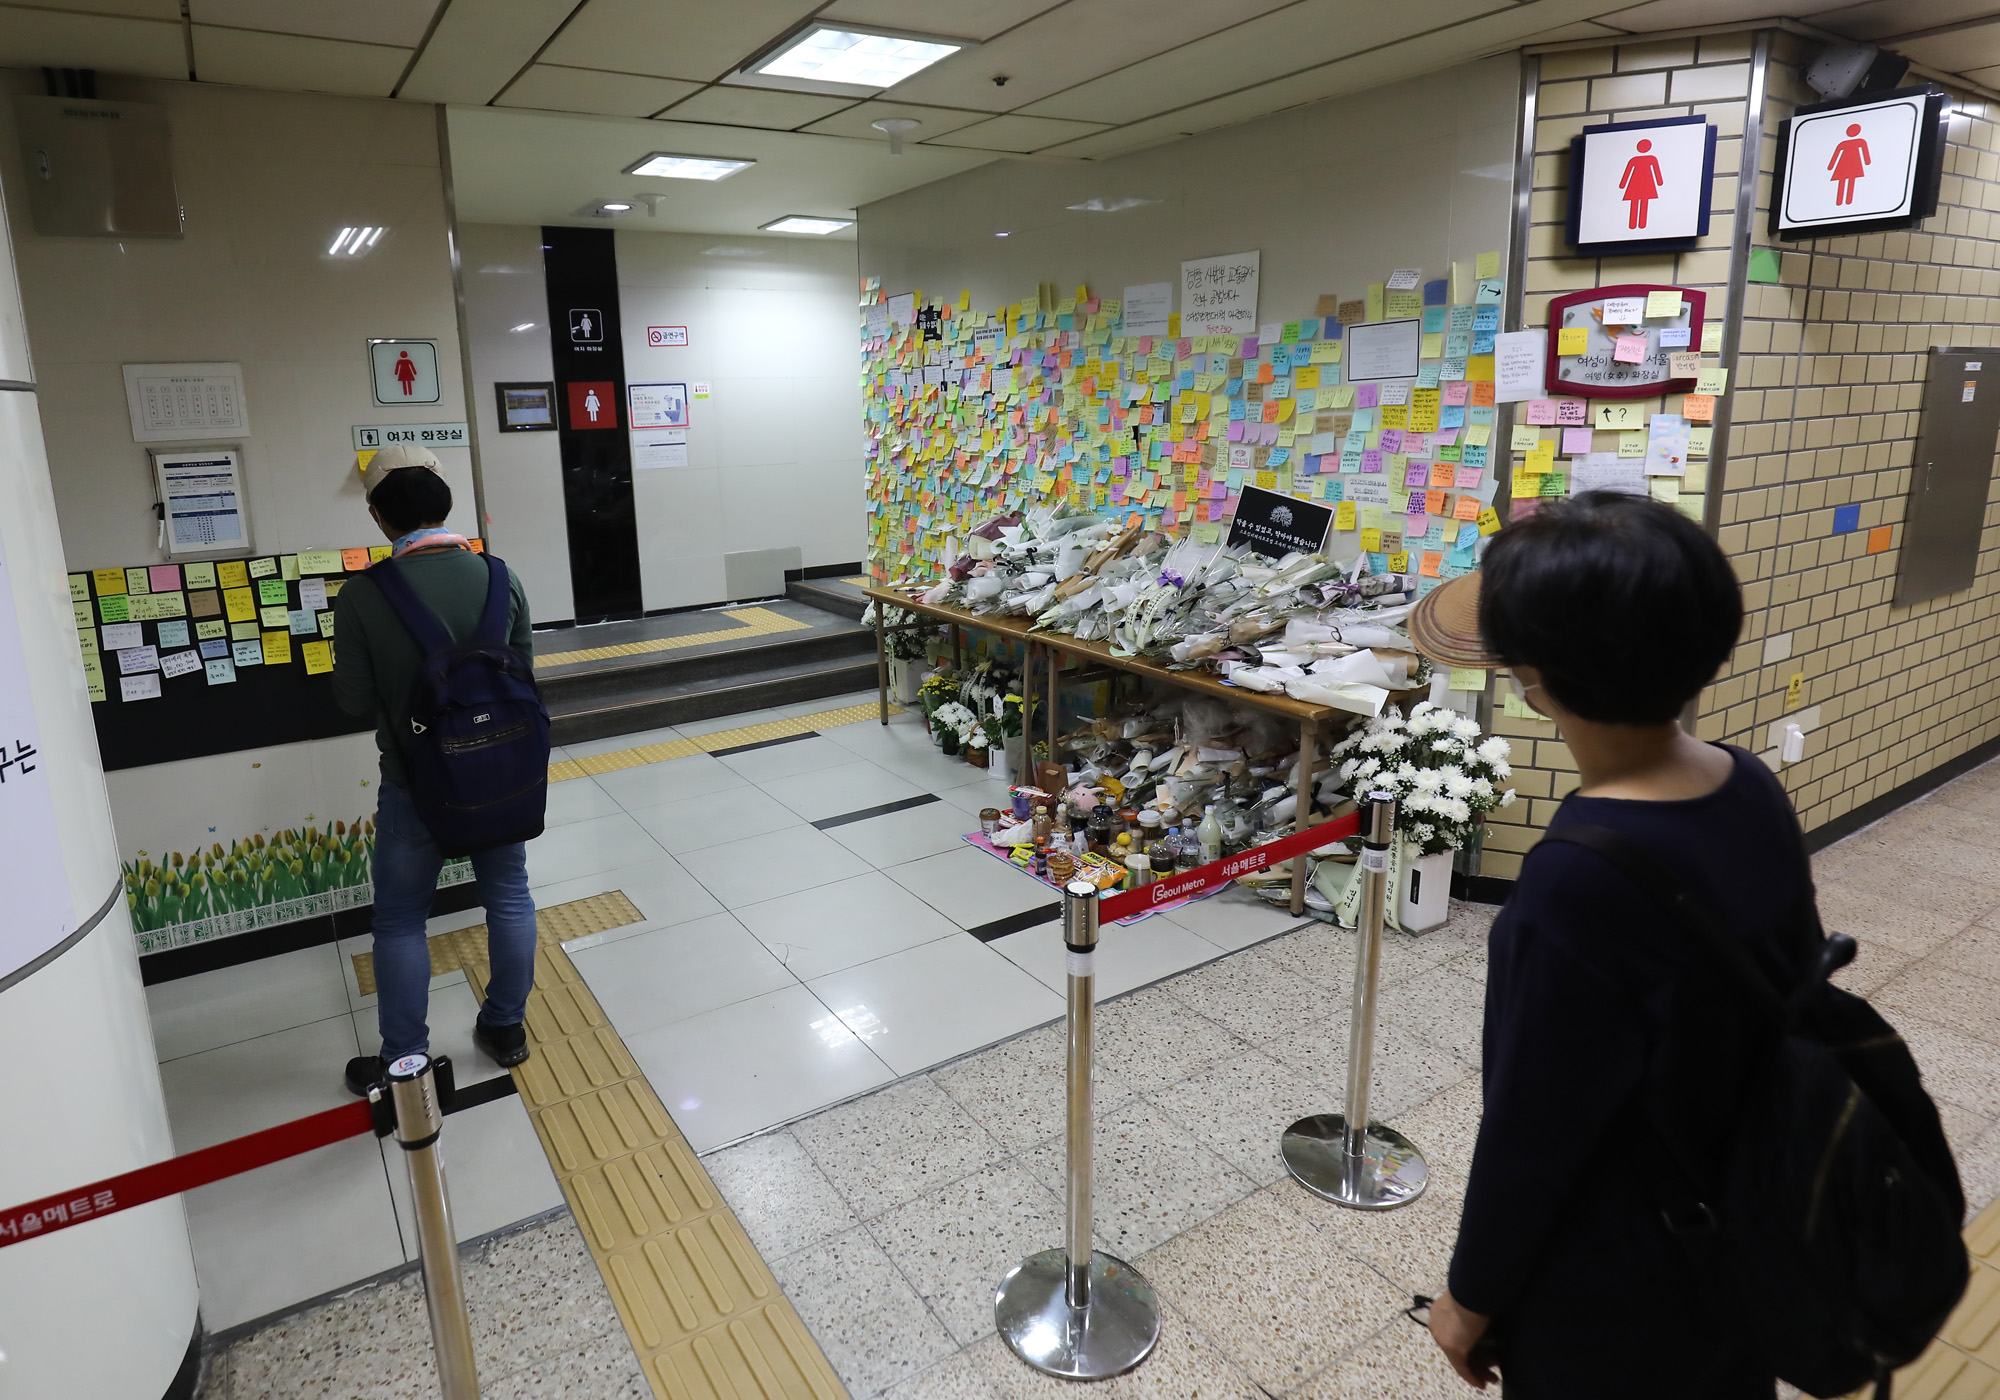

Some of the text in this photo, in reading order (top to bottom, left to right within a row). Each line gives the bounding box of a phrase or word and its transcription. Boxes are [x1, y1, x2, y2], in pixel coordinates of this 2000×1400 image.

[662, 331, 685, 340] 금연구역
[1577, 356, 1608, 367] 여성이
[1646, 353, 1669, 366] 서울
[1632, 370, 1660, 380] 화장실
[387, 429, 463, 441] 여자 화장실
[1221, 852, 1267, 877] 서울메트로
[1152, 883, 1181, 904] Seoul
[1181, 877, 1205, 893] Metro
[0, 1189, 117, 1240] 서울메트로
